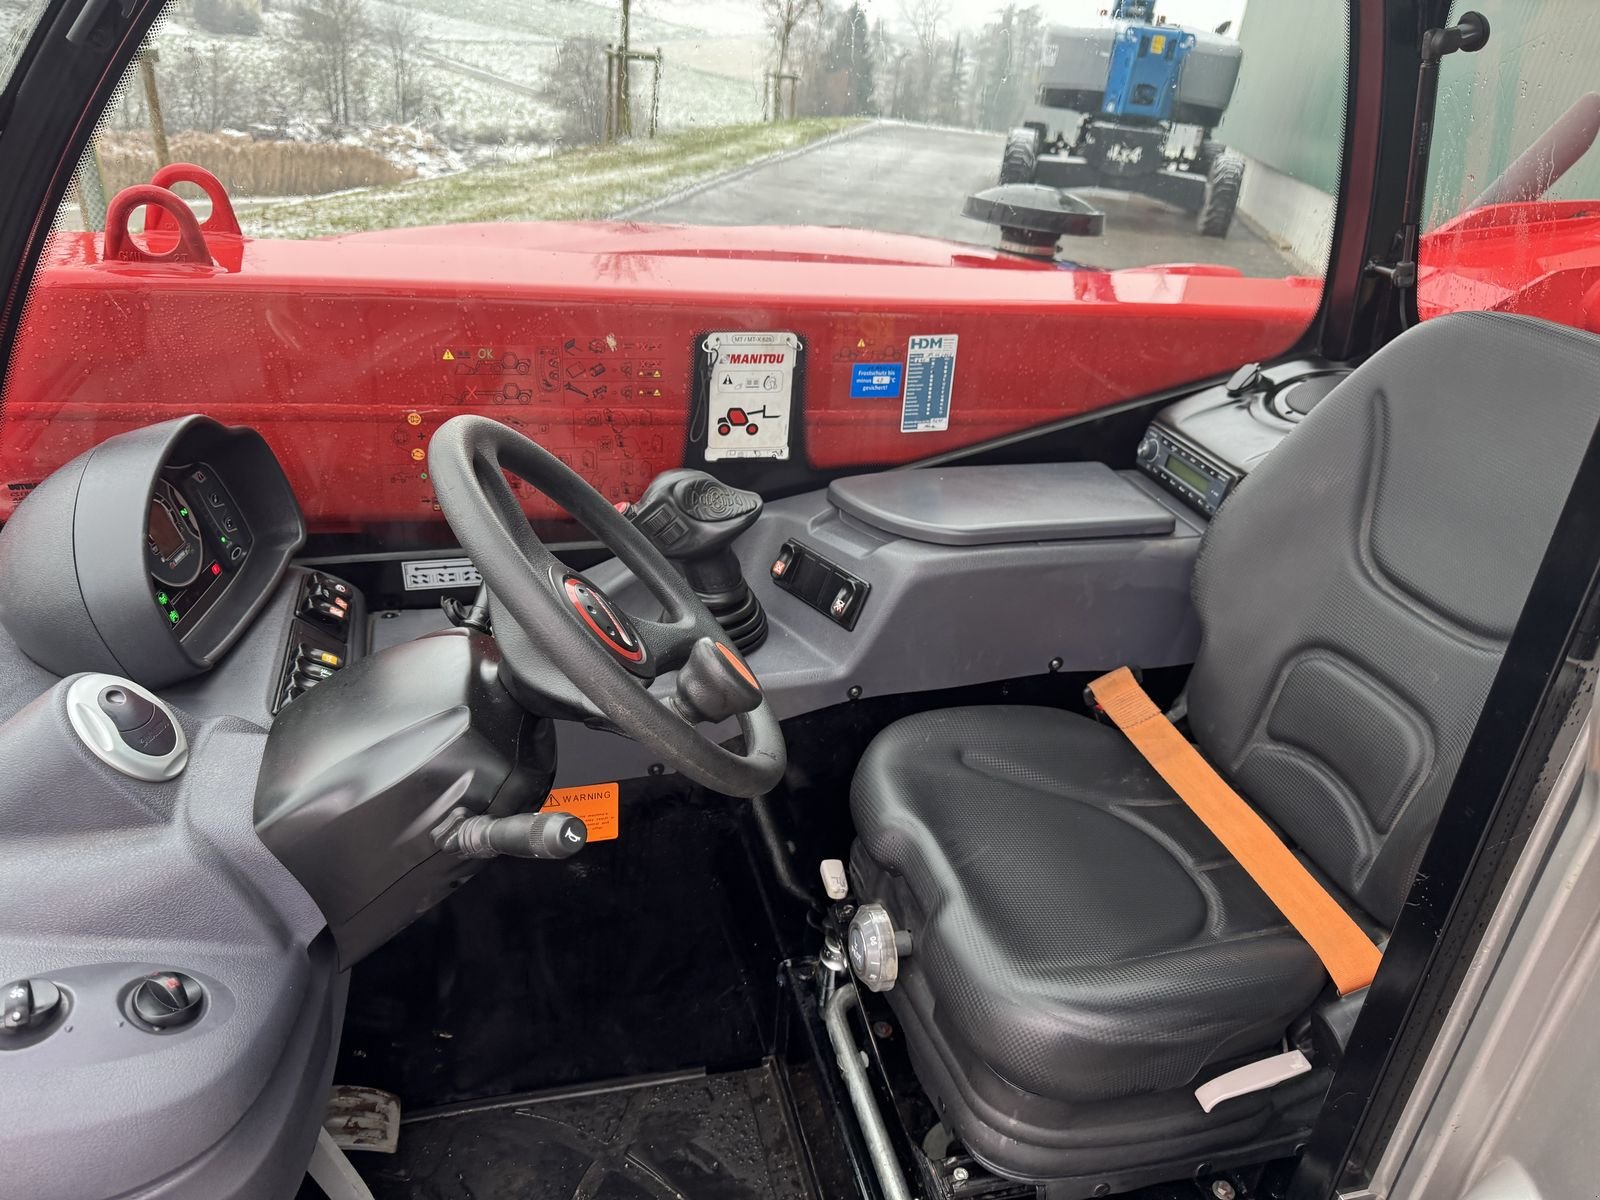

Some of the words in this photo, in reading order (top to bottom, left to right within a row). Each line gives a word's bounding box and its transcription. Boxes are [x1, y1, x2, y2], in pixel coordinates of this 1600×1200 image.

[910, 337, 943, 350] HDM
[477, 348, 494, 359] OK
[729, 353, 785, 364] MANITOU
[562, 791, 611, 803] WARNING
